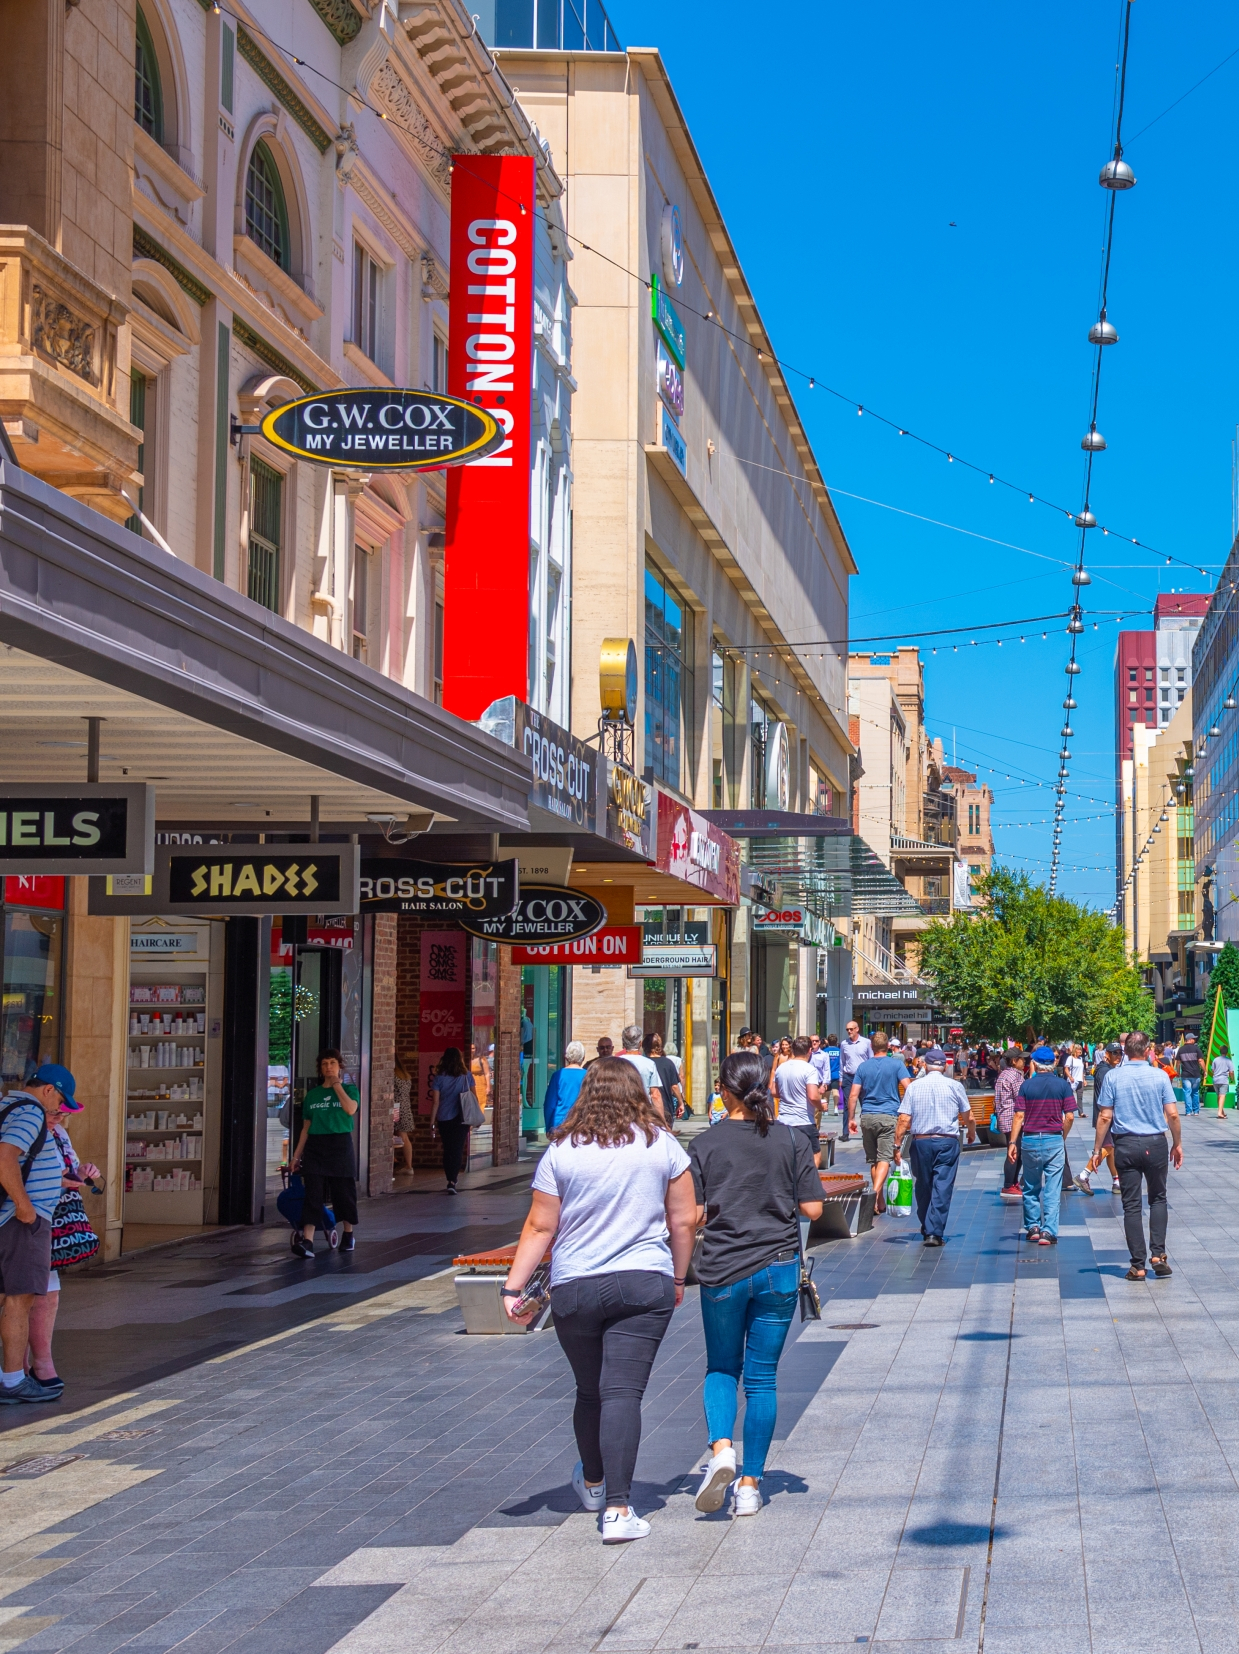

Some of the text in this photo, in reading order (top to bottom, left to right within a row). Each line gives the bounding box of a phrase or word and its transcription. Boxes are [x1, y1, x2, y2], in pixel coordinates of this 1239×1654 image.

[303, 403, 456, 430] G.W. COX
[306, 434, 453, 451] MY JEWELLER
[524, 726, 590, 803] CROSS CUT
[0, 811, 101, 846] ELS
[116, 878, 141, 886] REGENT
[191, 863, 319, 897] SHADES
[446, 877, 505, 899] CUT
[401, 902, 464, 911] HAIR SALON
[526, 900, 588, 921] COX
[483, 922, 574, 936] MY JEWELLER
[131, 938, 182, 948] HAIRCARE
[858, 990, 900, 999] michael
[903, 990, 917, 999] hill
[421, 1009, 455, 1023] 50%
[917, 1011, 928, 1019] hill
[432, 1023, 463, 1037] OFF
[53, 1232, 98, 1249] LONDON
